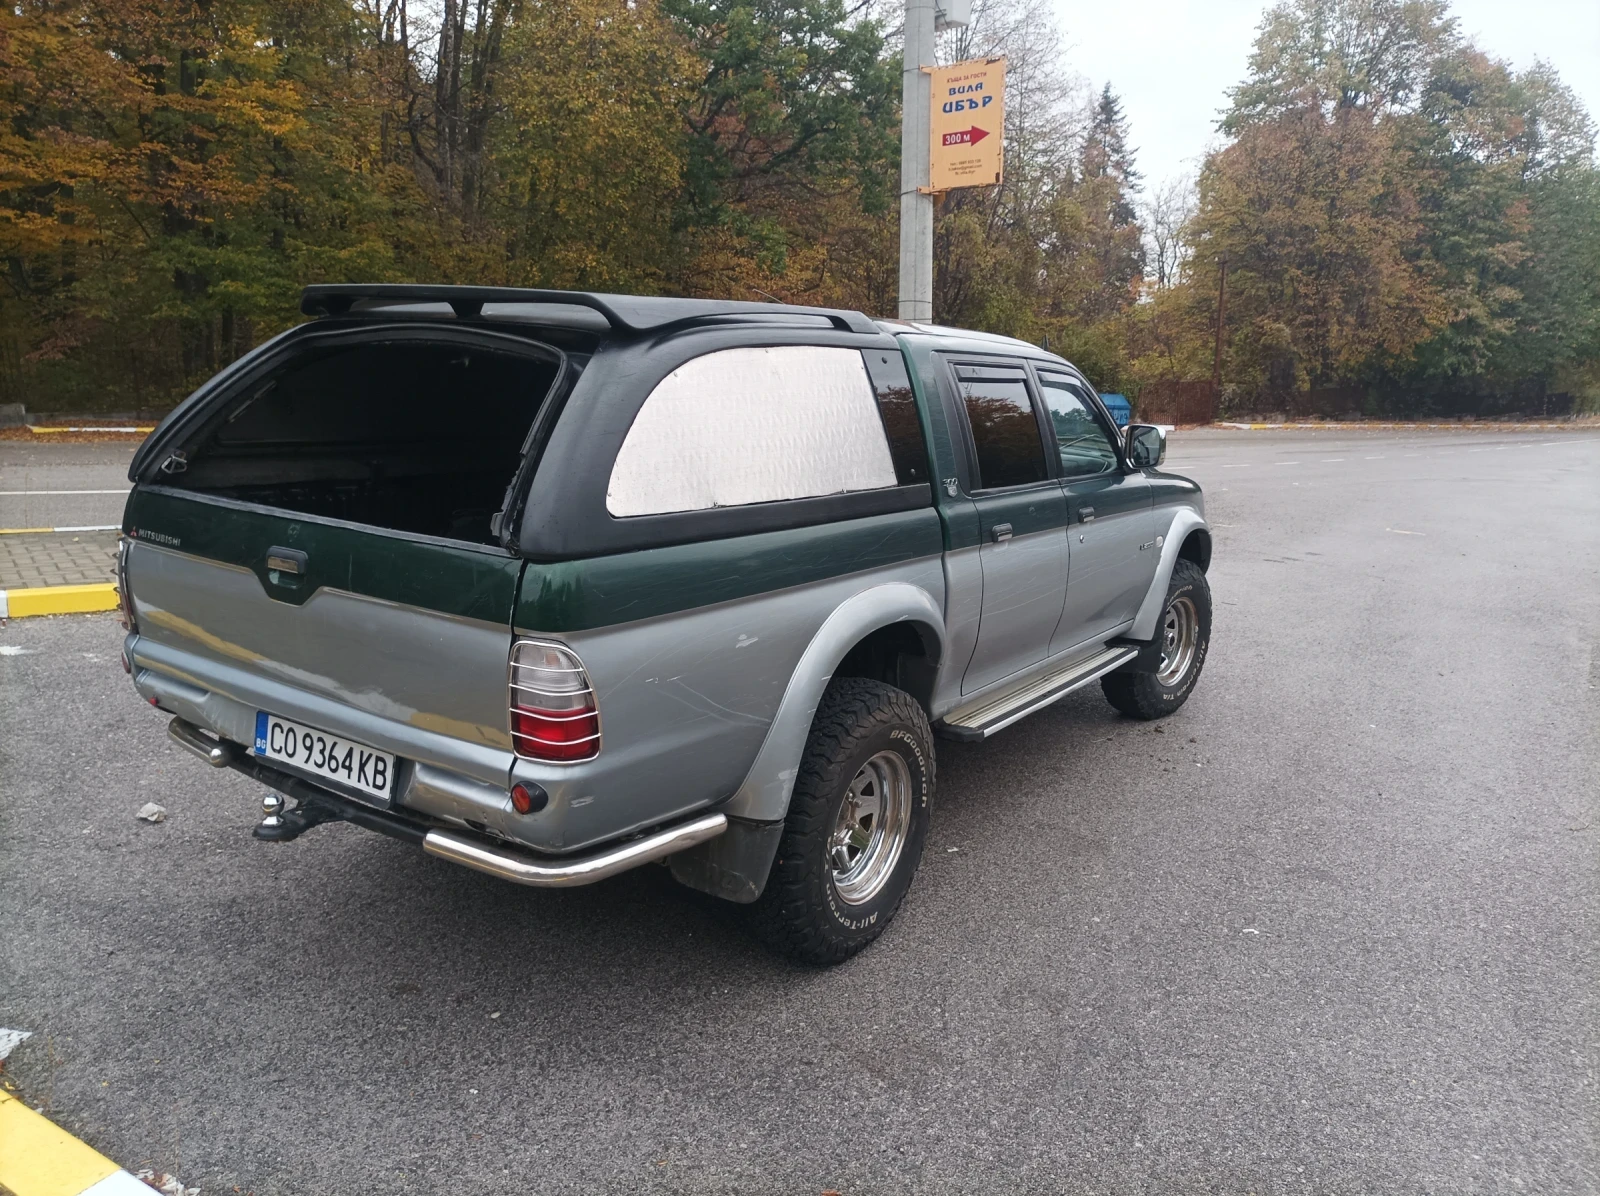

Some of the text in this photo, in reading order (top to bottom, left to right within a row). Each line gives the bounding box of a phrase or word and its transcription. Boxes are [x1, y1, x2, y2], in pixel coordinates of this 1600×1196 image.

[945, 133, 961, 145] 300
[138, 528, 181, 546] MITSUBISHI
[256, 738, 266, 749] BG
[890, 730, 927, 808] BFGoodrich
